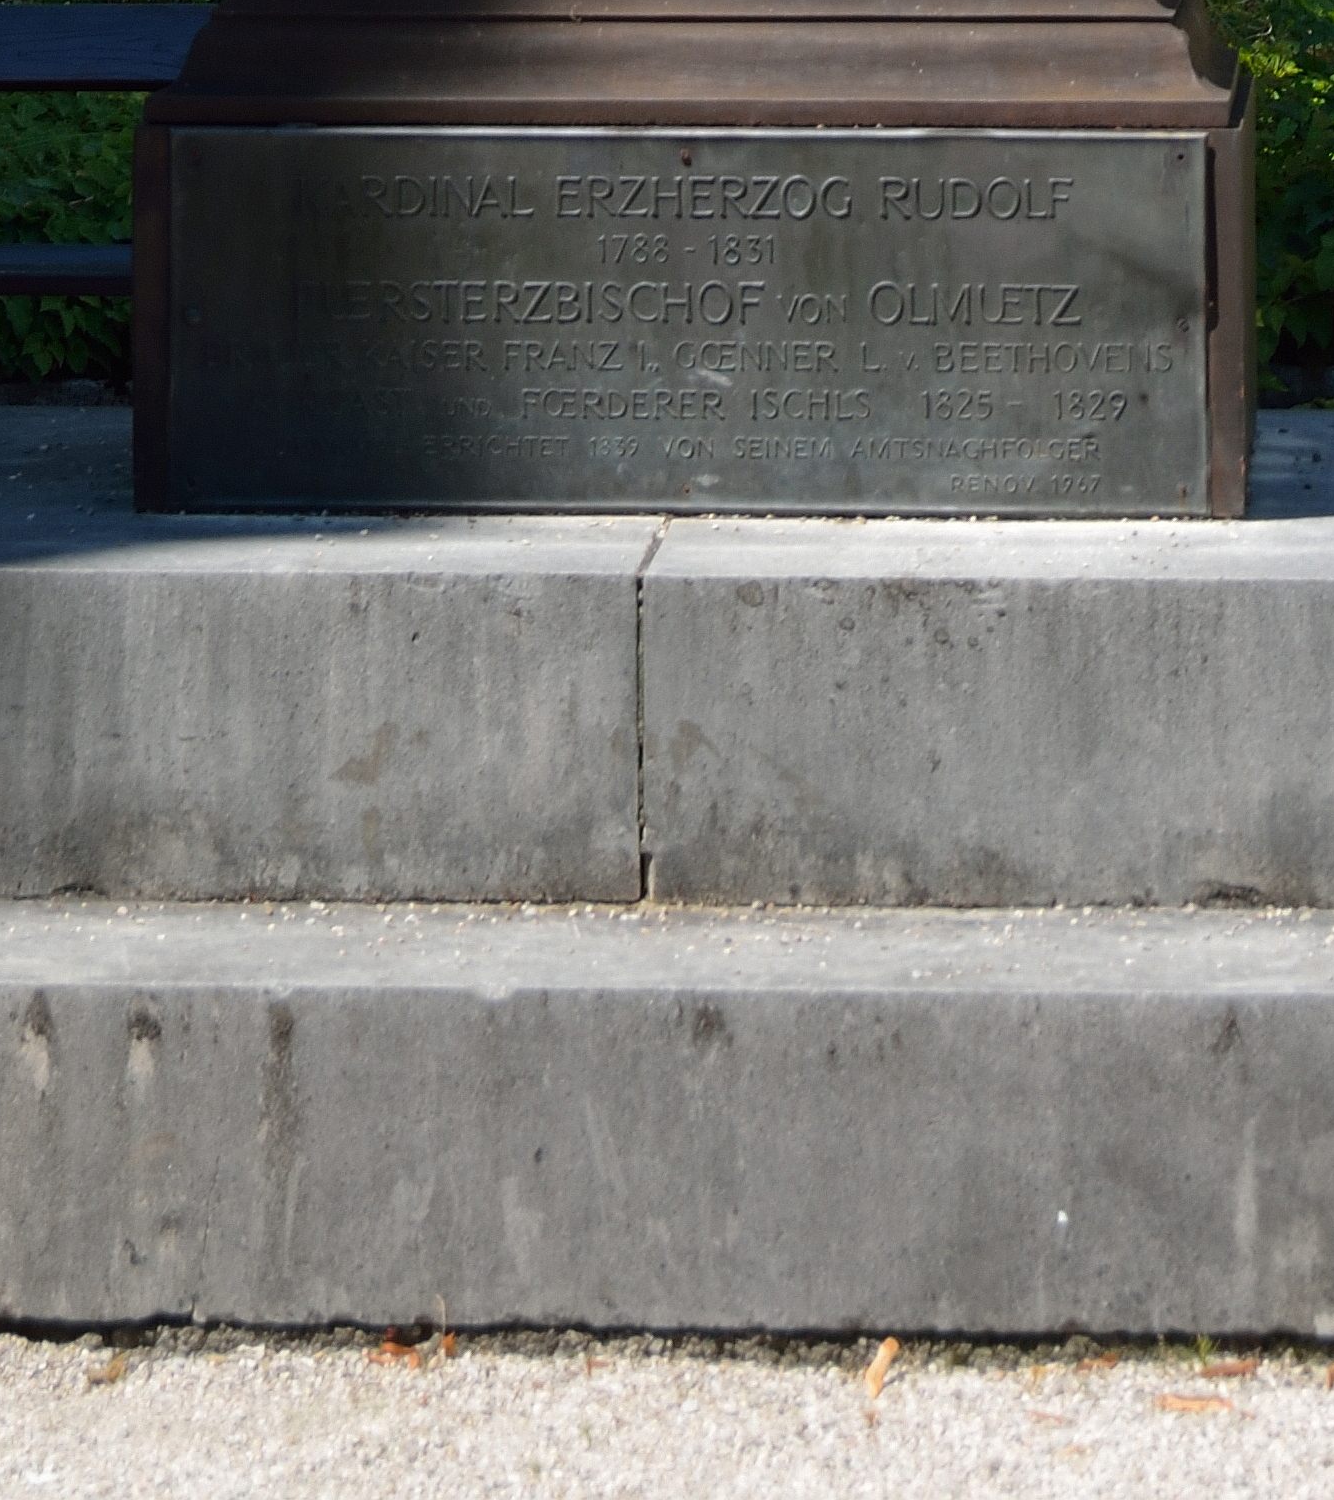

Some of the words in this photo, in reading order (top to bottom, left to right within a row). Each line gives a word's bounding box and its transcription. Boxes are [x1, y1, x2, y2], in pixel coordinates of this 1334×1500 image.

[297, 173, 535, 220] KARDINAL
[555, 173, 854, 222] ERZHERZOG
[878, 174, 1075, 222] RUDOLF
[597, 232, 670, 266] 1788
[707, 233, 776, 266] 1831
[361, 338, 488, 373] KAISER
[503, 339, 624, 373] FRANZ
[860, 341, 887, 373] L.
[933, 341, 1173, 374] BEETHOVENS
[750, 386, 872, 422] ISCHLS
[920, 388, 994, 422] 1825
[1052, 388, 1128, 422] 1829
[422, 432, 570, 458] ERRICHTET
[587, 434, 640, 459] 1839
[658, 435, 715, 459] VON
[733, 435, 834, 459] SEINEM
[849, 436, 1101, 461] AMTSNACHFOLGER
[1050, 473, 1102, 494] 1967
